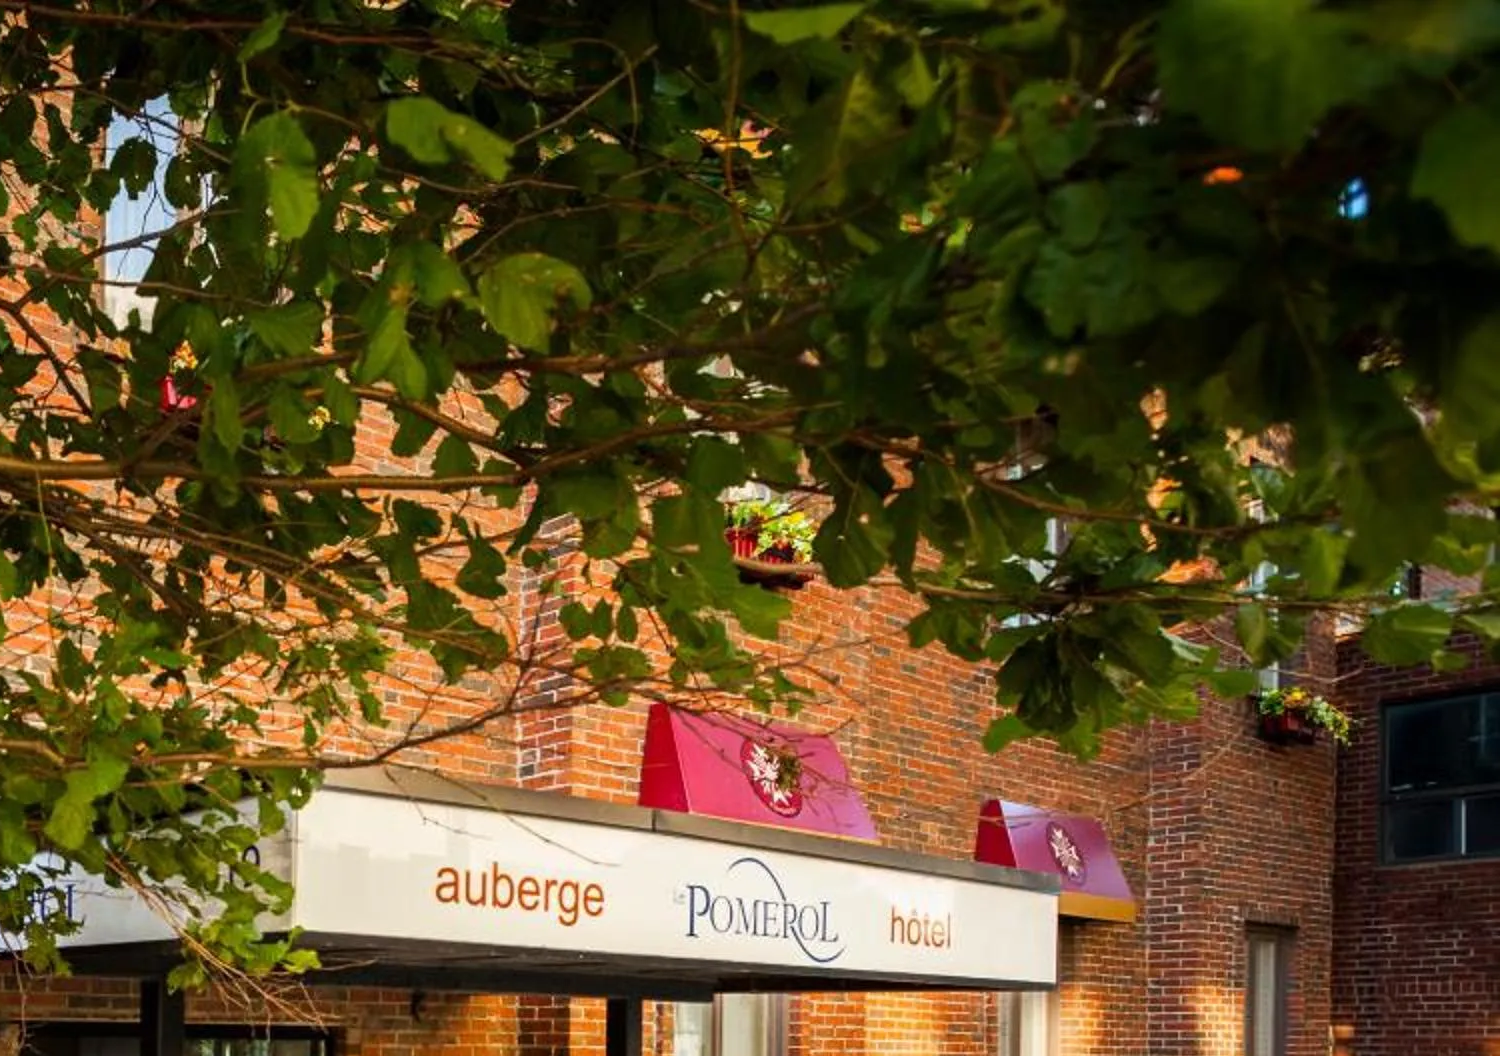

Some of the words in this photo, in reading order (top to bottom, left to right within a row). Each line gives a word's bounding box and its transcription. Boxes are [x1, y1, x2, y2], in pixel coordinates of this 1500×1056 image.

[435, 861, 605, 926] auberge
[686, 885, 846, 962] POMEROL
[890, 904, 951, 949] hôtel
